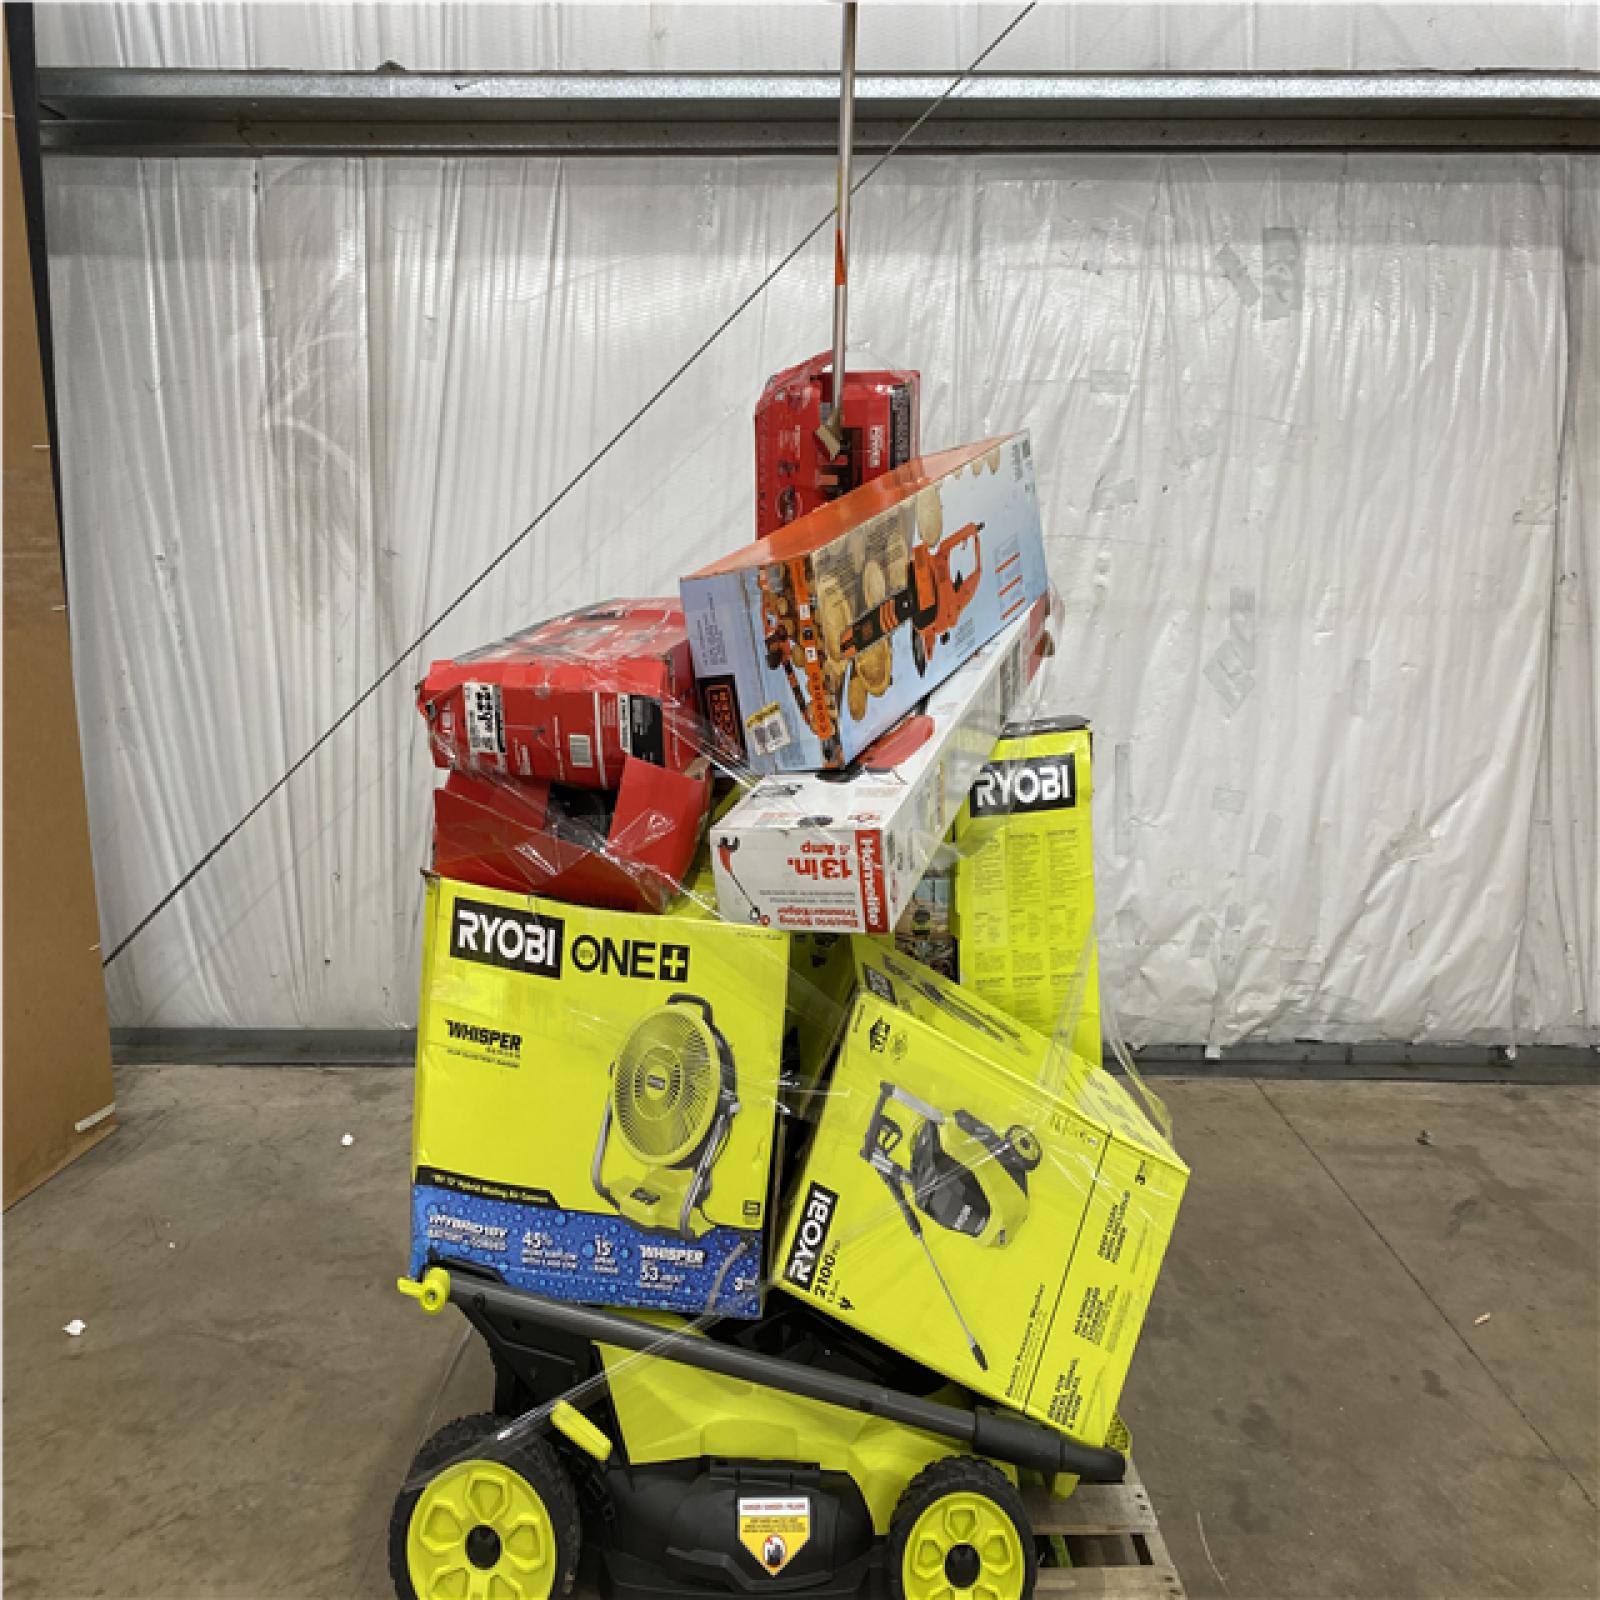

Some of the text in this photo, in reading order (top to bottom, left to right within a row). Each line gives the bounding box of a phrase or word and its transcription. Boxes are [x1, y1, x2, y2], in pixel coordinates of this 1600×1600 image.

[975, 765, 1072, 808] RYOBI
[787, 857, 853, 881] 13 in.
[457, 909, 557, 967] RYOBI
[445, 1019, 523, 1051] WHISPER
[789, 1190, 832, 1283] RYOBI
[814, 1253, 836, 1297] 2100
